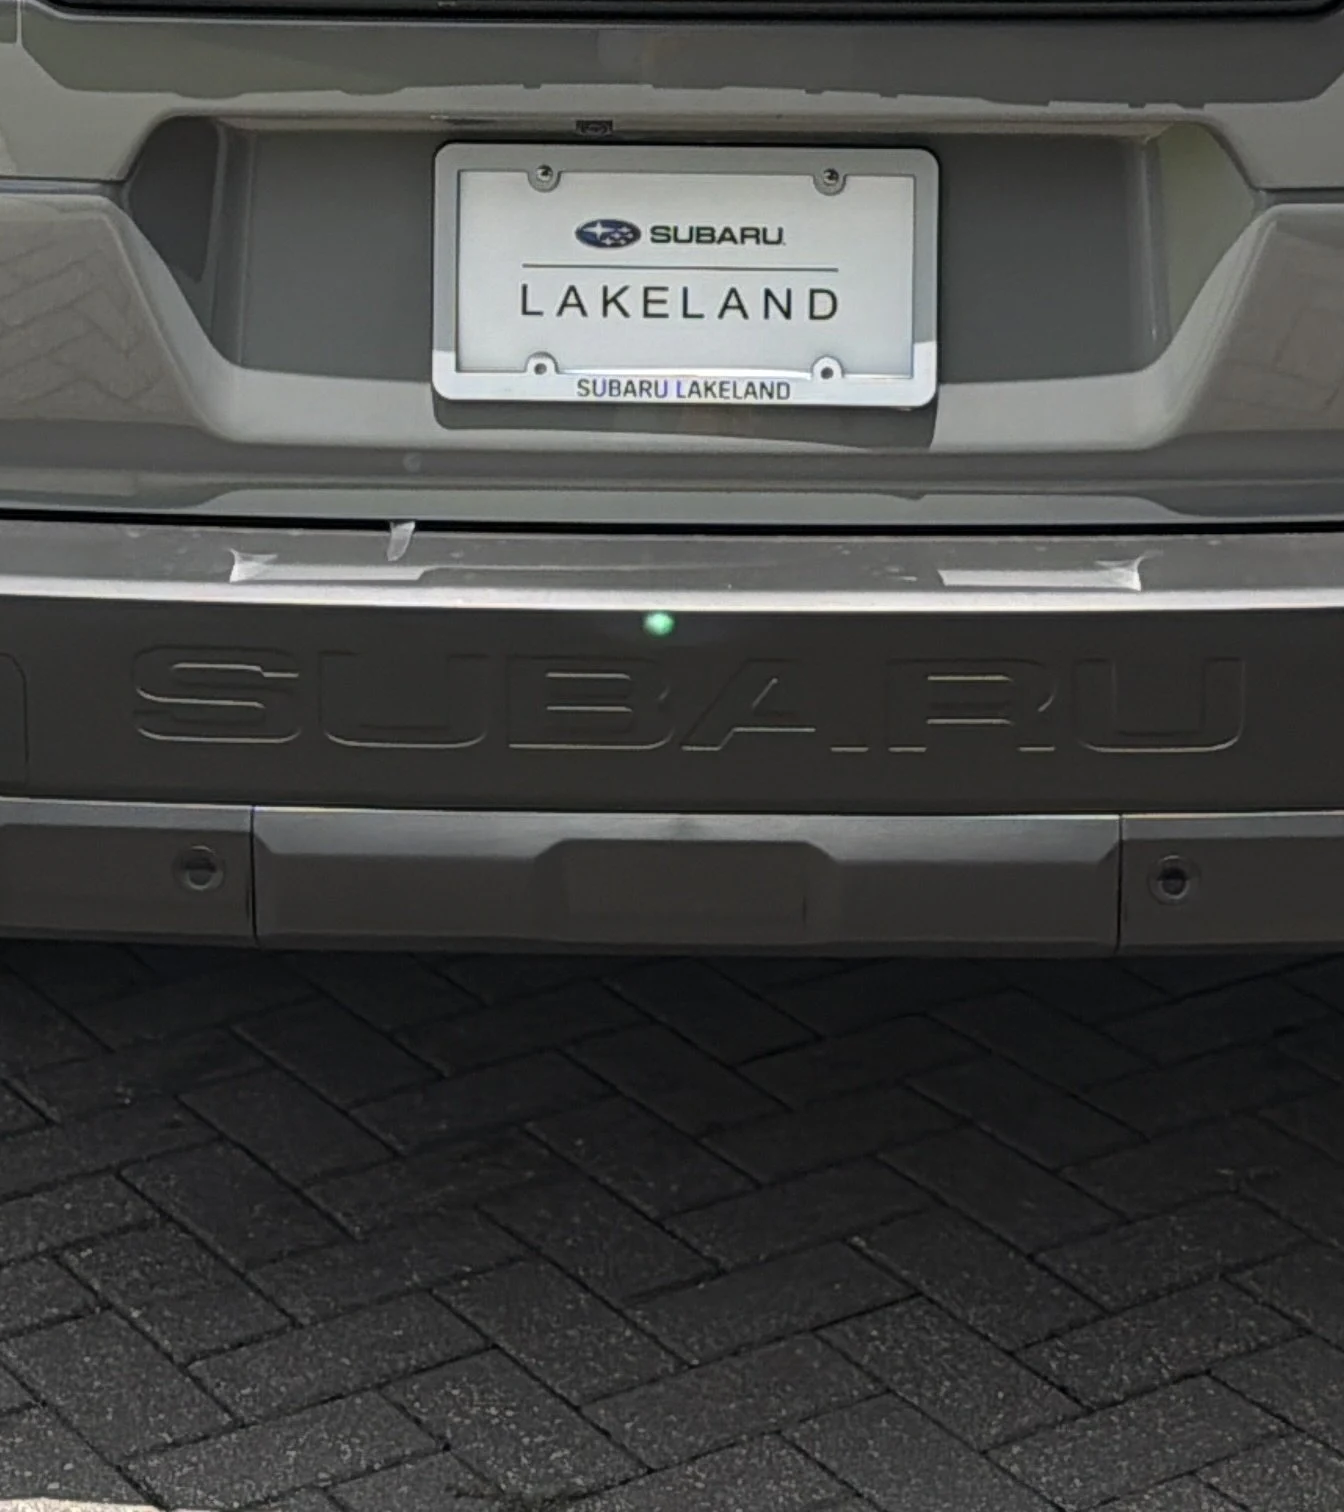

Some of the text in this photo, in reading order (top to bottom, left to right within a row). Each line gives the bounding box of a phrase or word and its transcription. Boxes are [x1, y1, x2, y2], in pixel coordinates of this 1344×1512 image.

[649, 225, 784, 246] SUBARU
[520, 283, 838, 321] LAKELAND
[576, 378, 791, 401] SUBARU LAKELAND
[132, 645, 1244, 752] SUBARU
